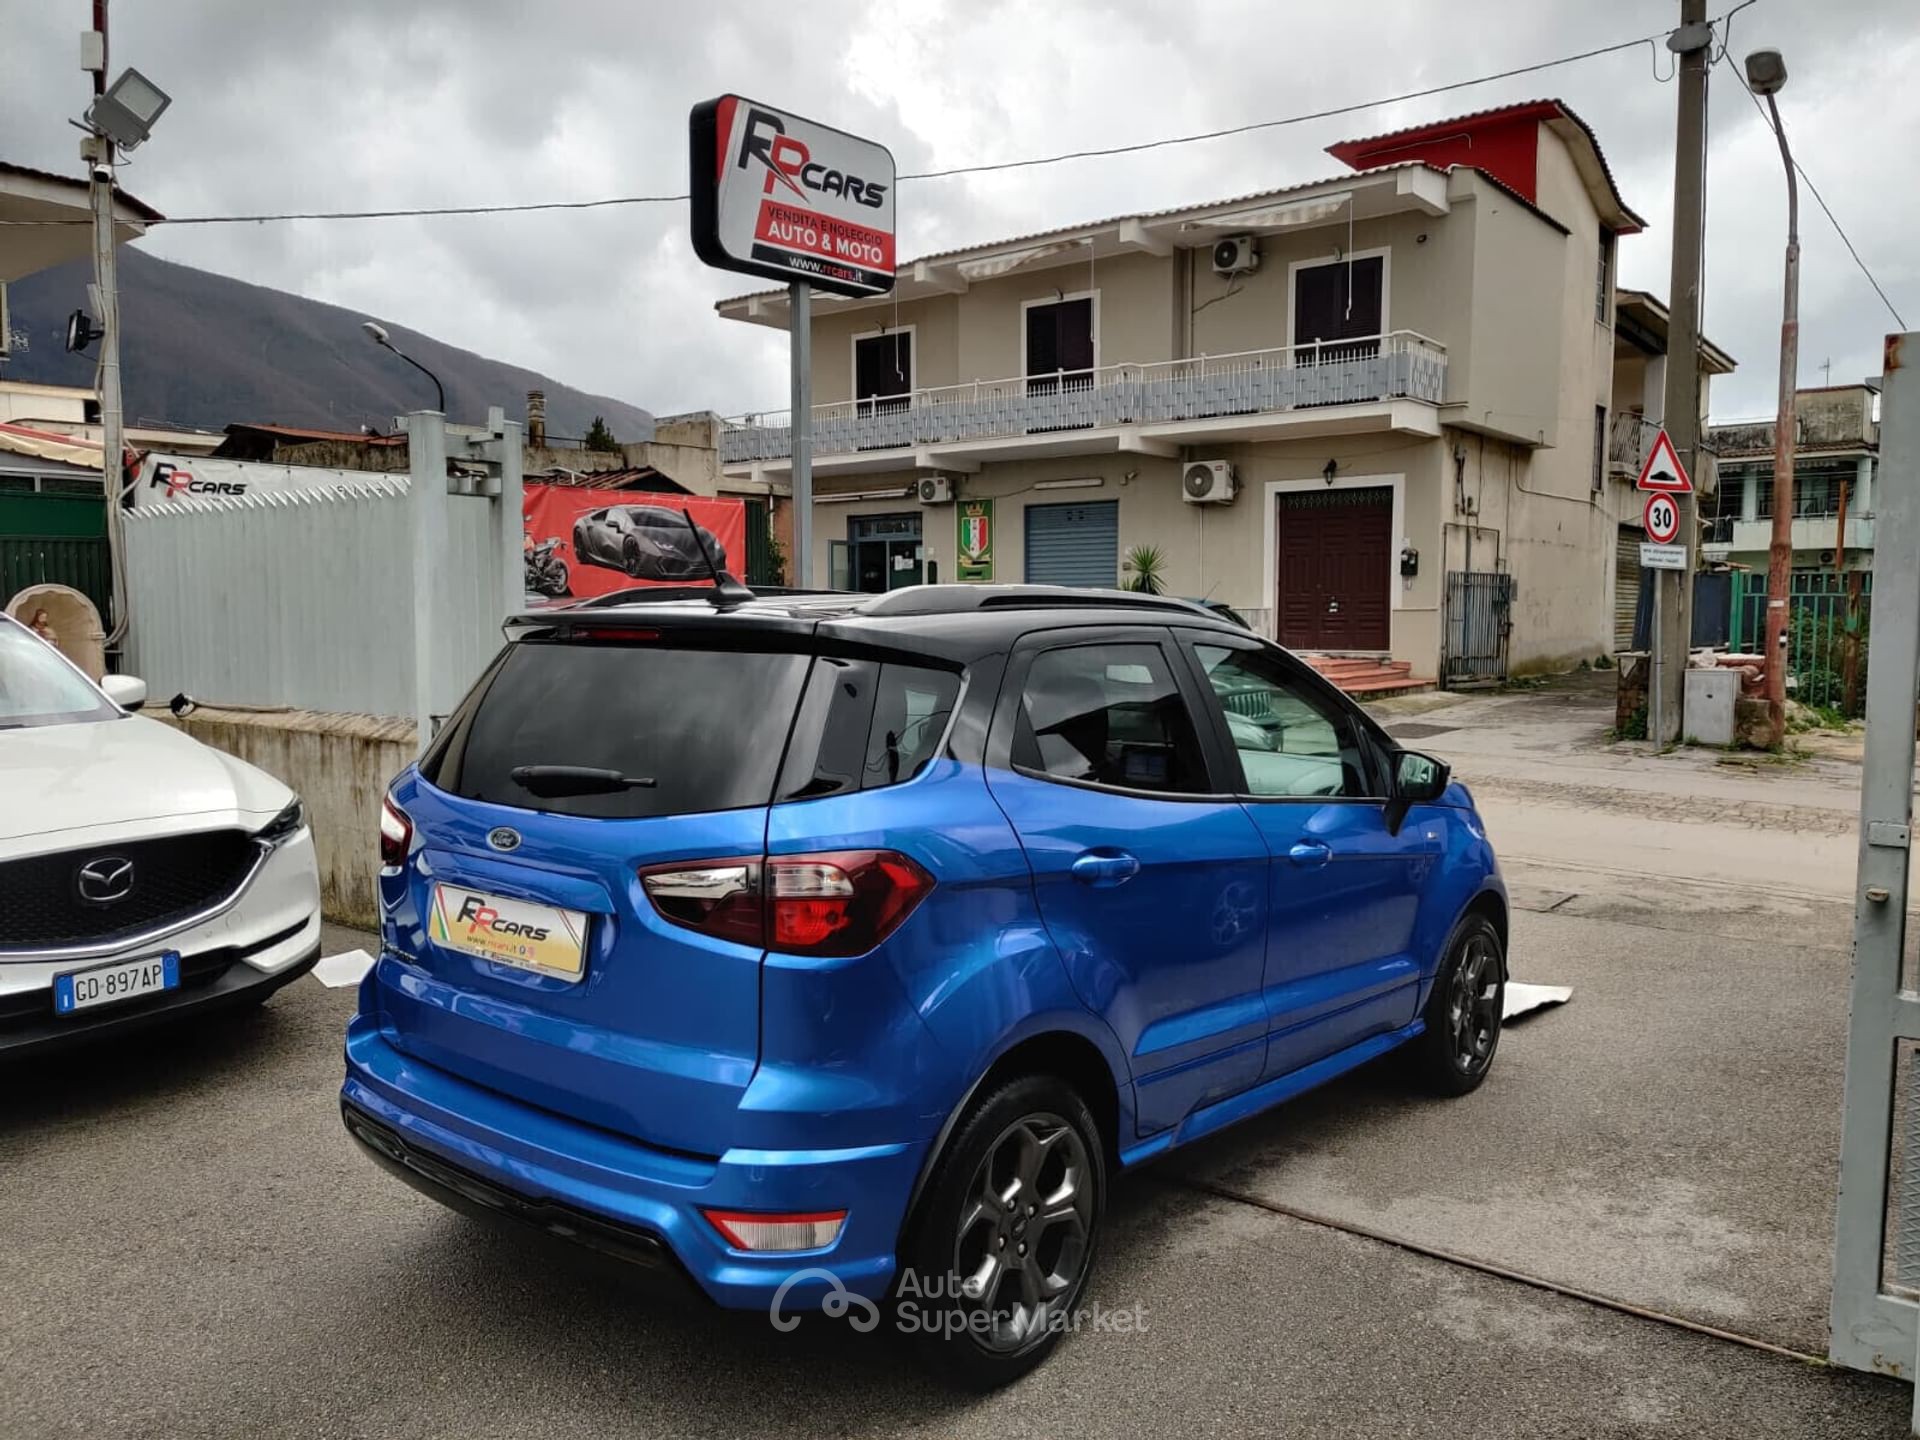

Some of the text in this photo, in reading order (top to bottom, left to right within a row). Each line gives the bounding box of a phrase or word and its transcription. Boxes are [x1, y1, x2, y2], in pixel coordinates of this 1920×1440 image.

[801, 163, 888, 209] CARS
[768, 206, 883, 246] VENDITA E NOLEGGIO
[768, 221, 883, 264] AUTO & MOTO
[789, 256, 864, 283] www.rrcars.it
[189, 481, 247, 495] CARS
[1653, 507, 1672, 528] 30
[491, 920, 551, 941] CARS
[76, 978, 99, 1001] GD
[106, 965, 162, 995] 897AP
